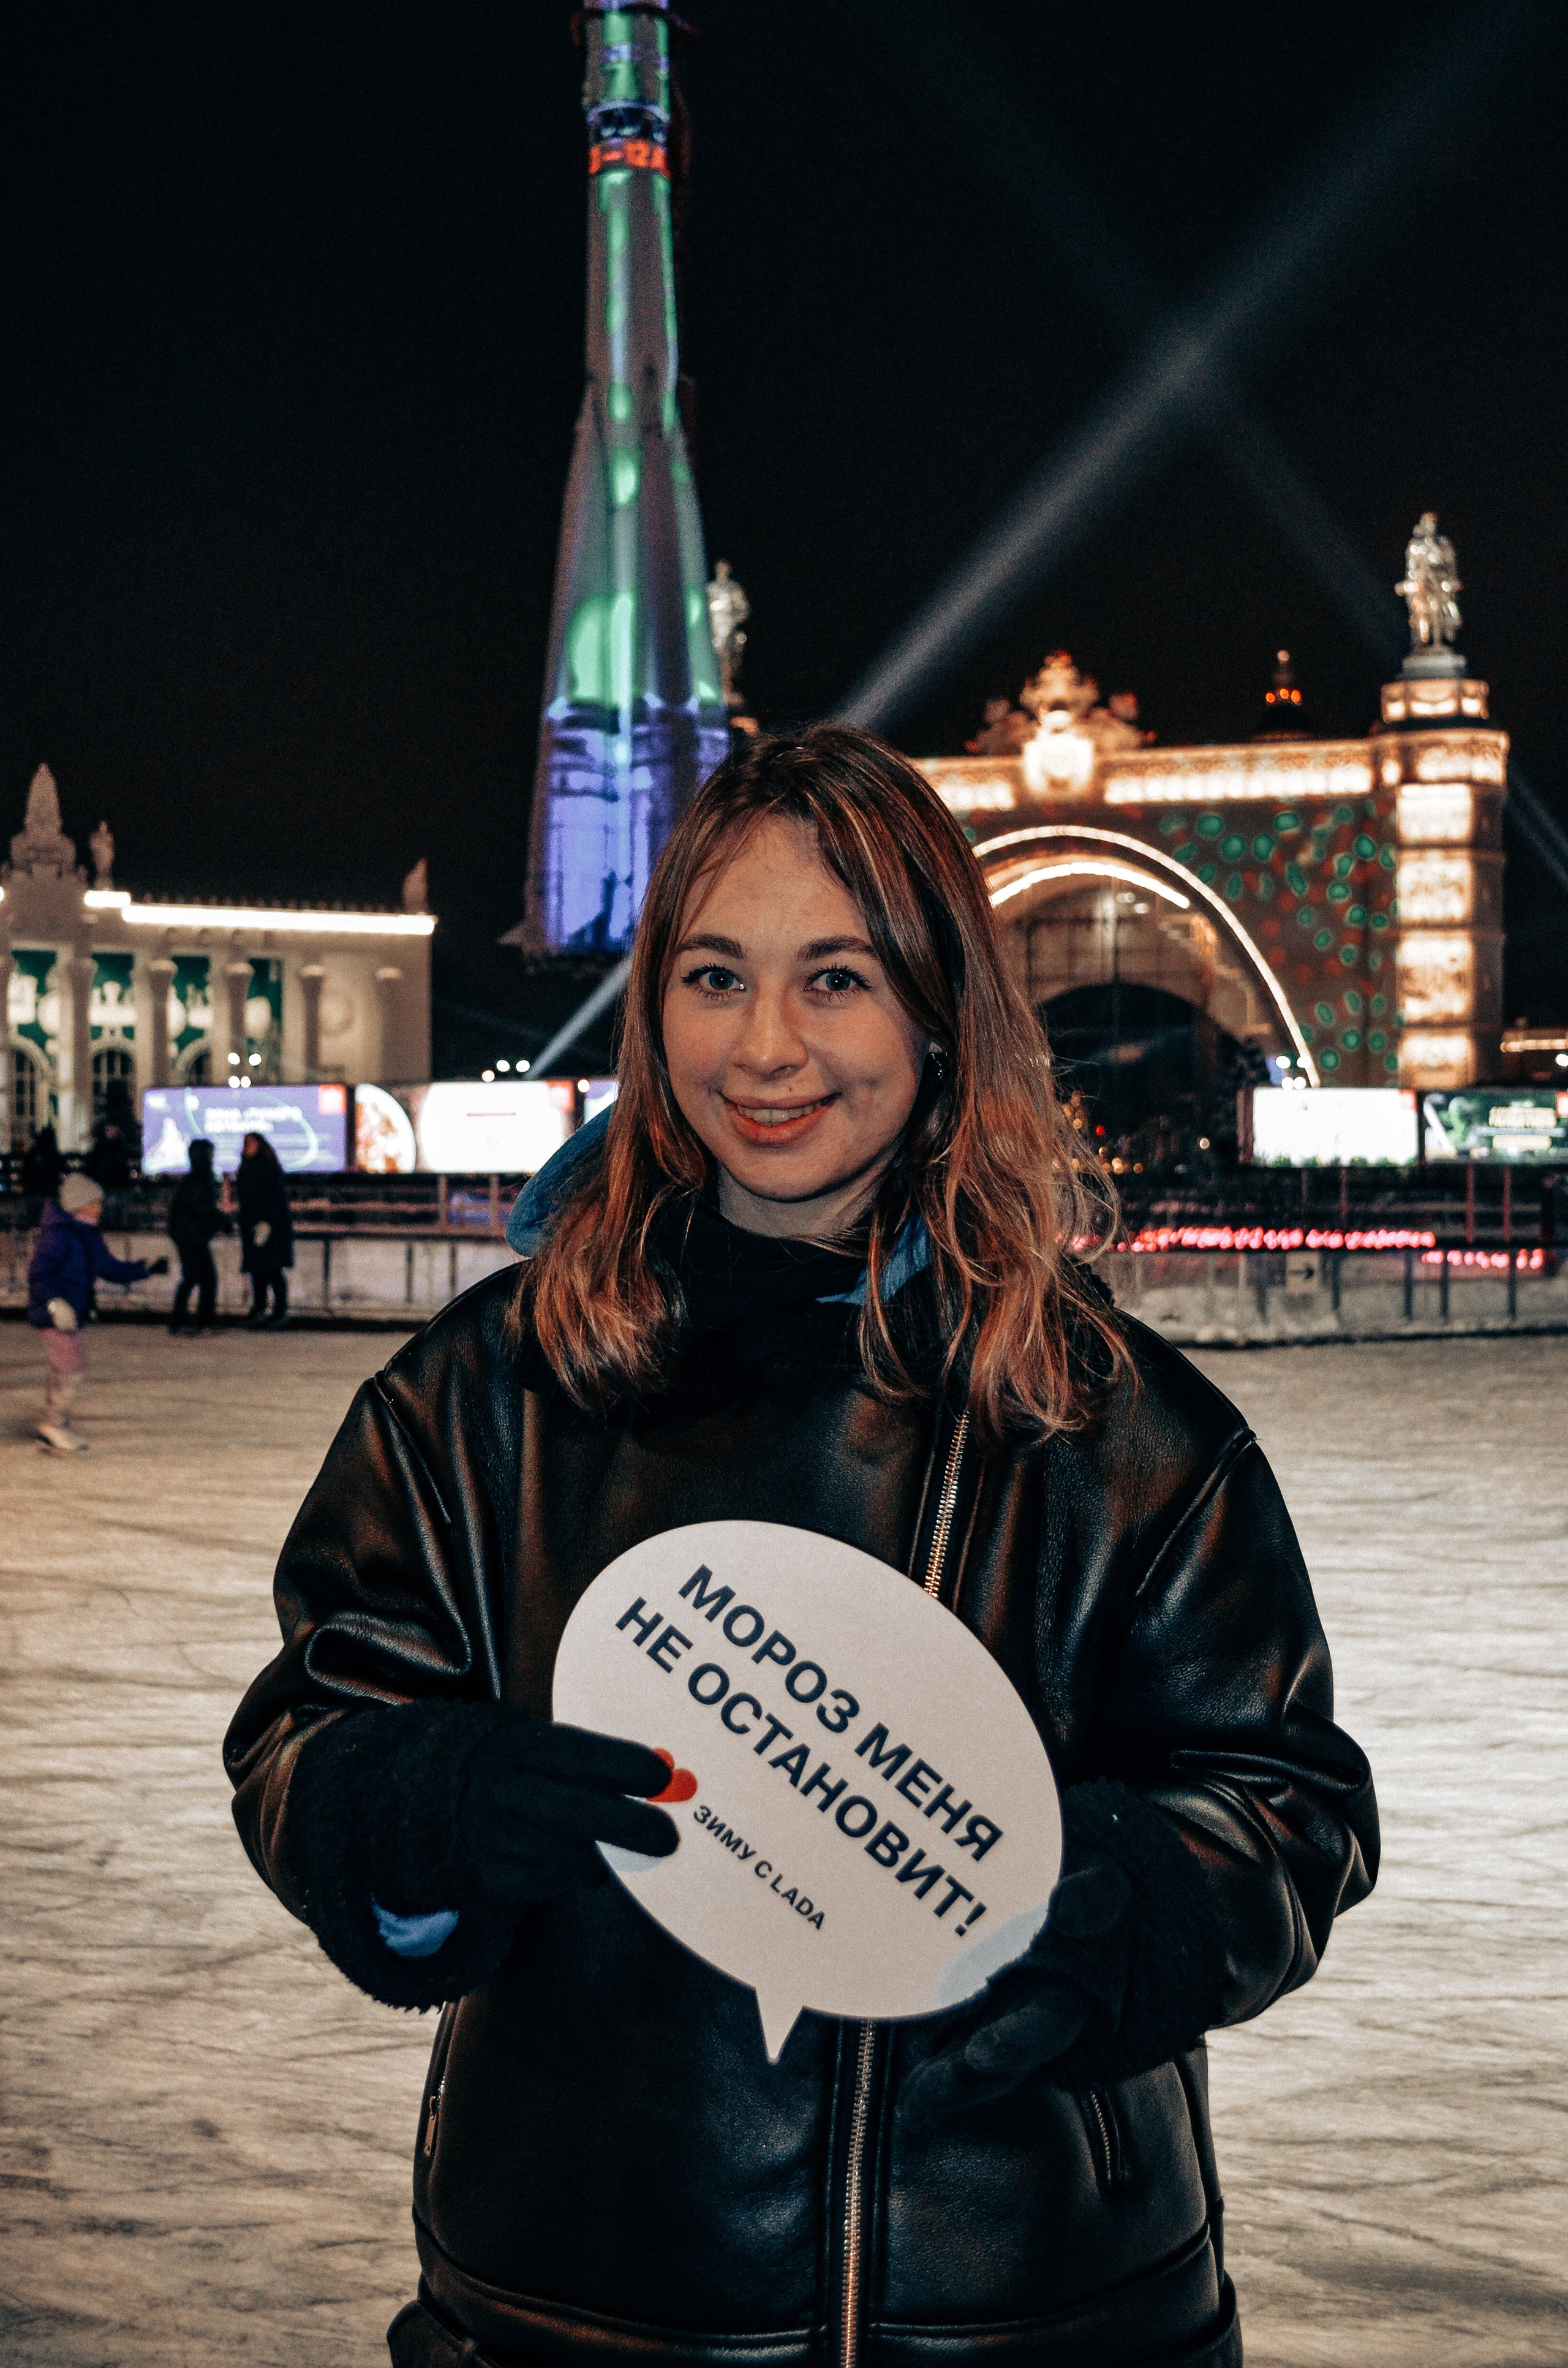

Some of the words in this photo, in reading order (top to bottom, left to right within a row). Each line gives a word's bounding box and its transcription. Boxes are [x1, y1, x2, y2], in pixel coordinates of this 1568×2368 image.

[615, 1597, 693, 1673] НЕ
[688, 1663, 987, 1938] ОСТАНОВИТ!
[679, 1565, 860, 1734] МОРОЗ
[854, 1722, 1003, 1863] МЕНЯ
[693, 1805, 756, 1861] ЗИМУ
[754, 1860, 772, 1879] С
[770, 1874, 825, 1931] LADA
